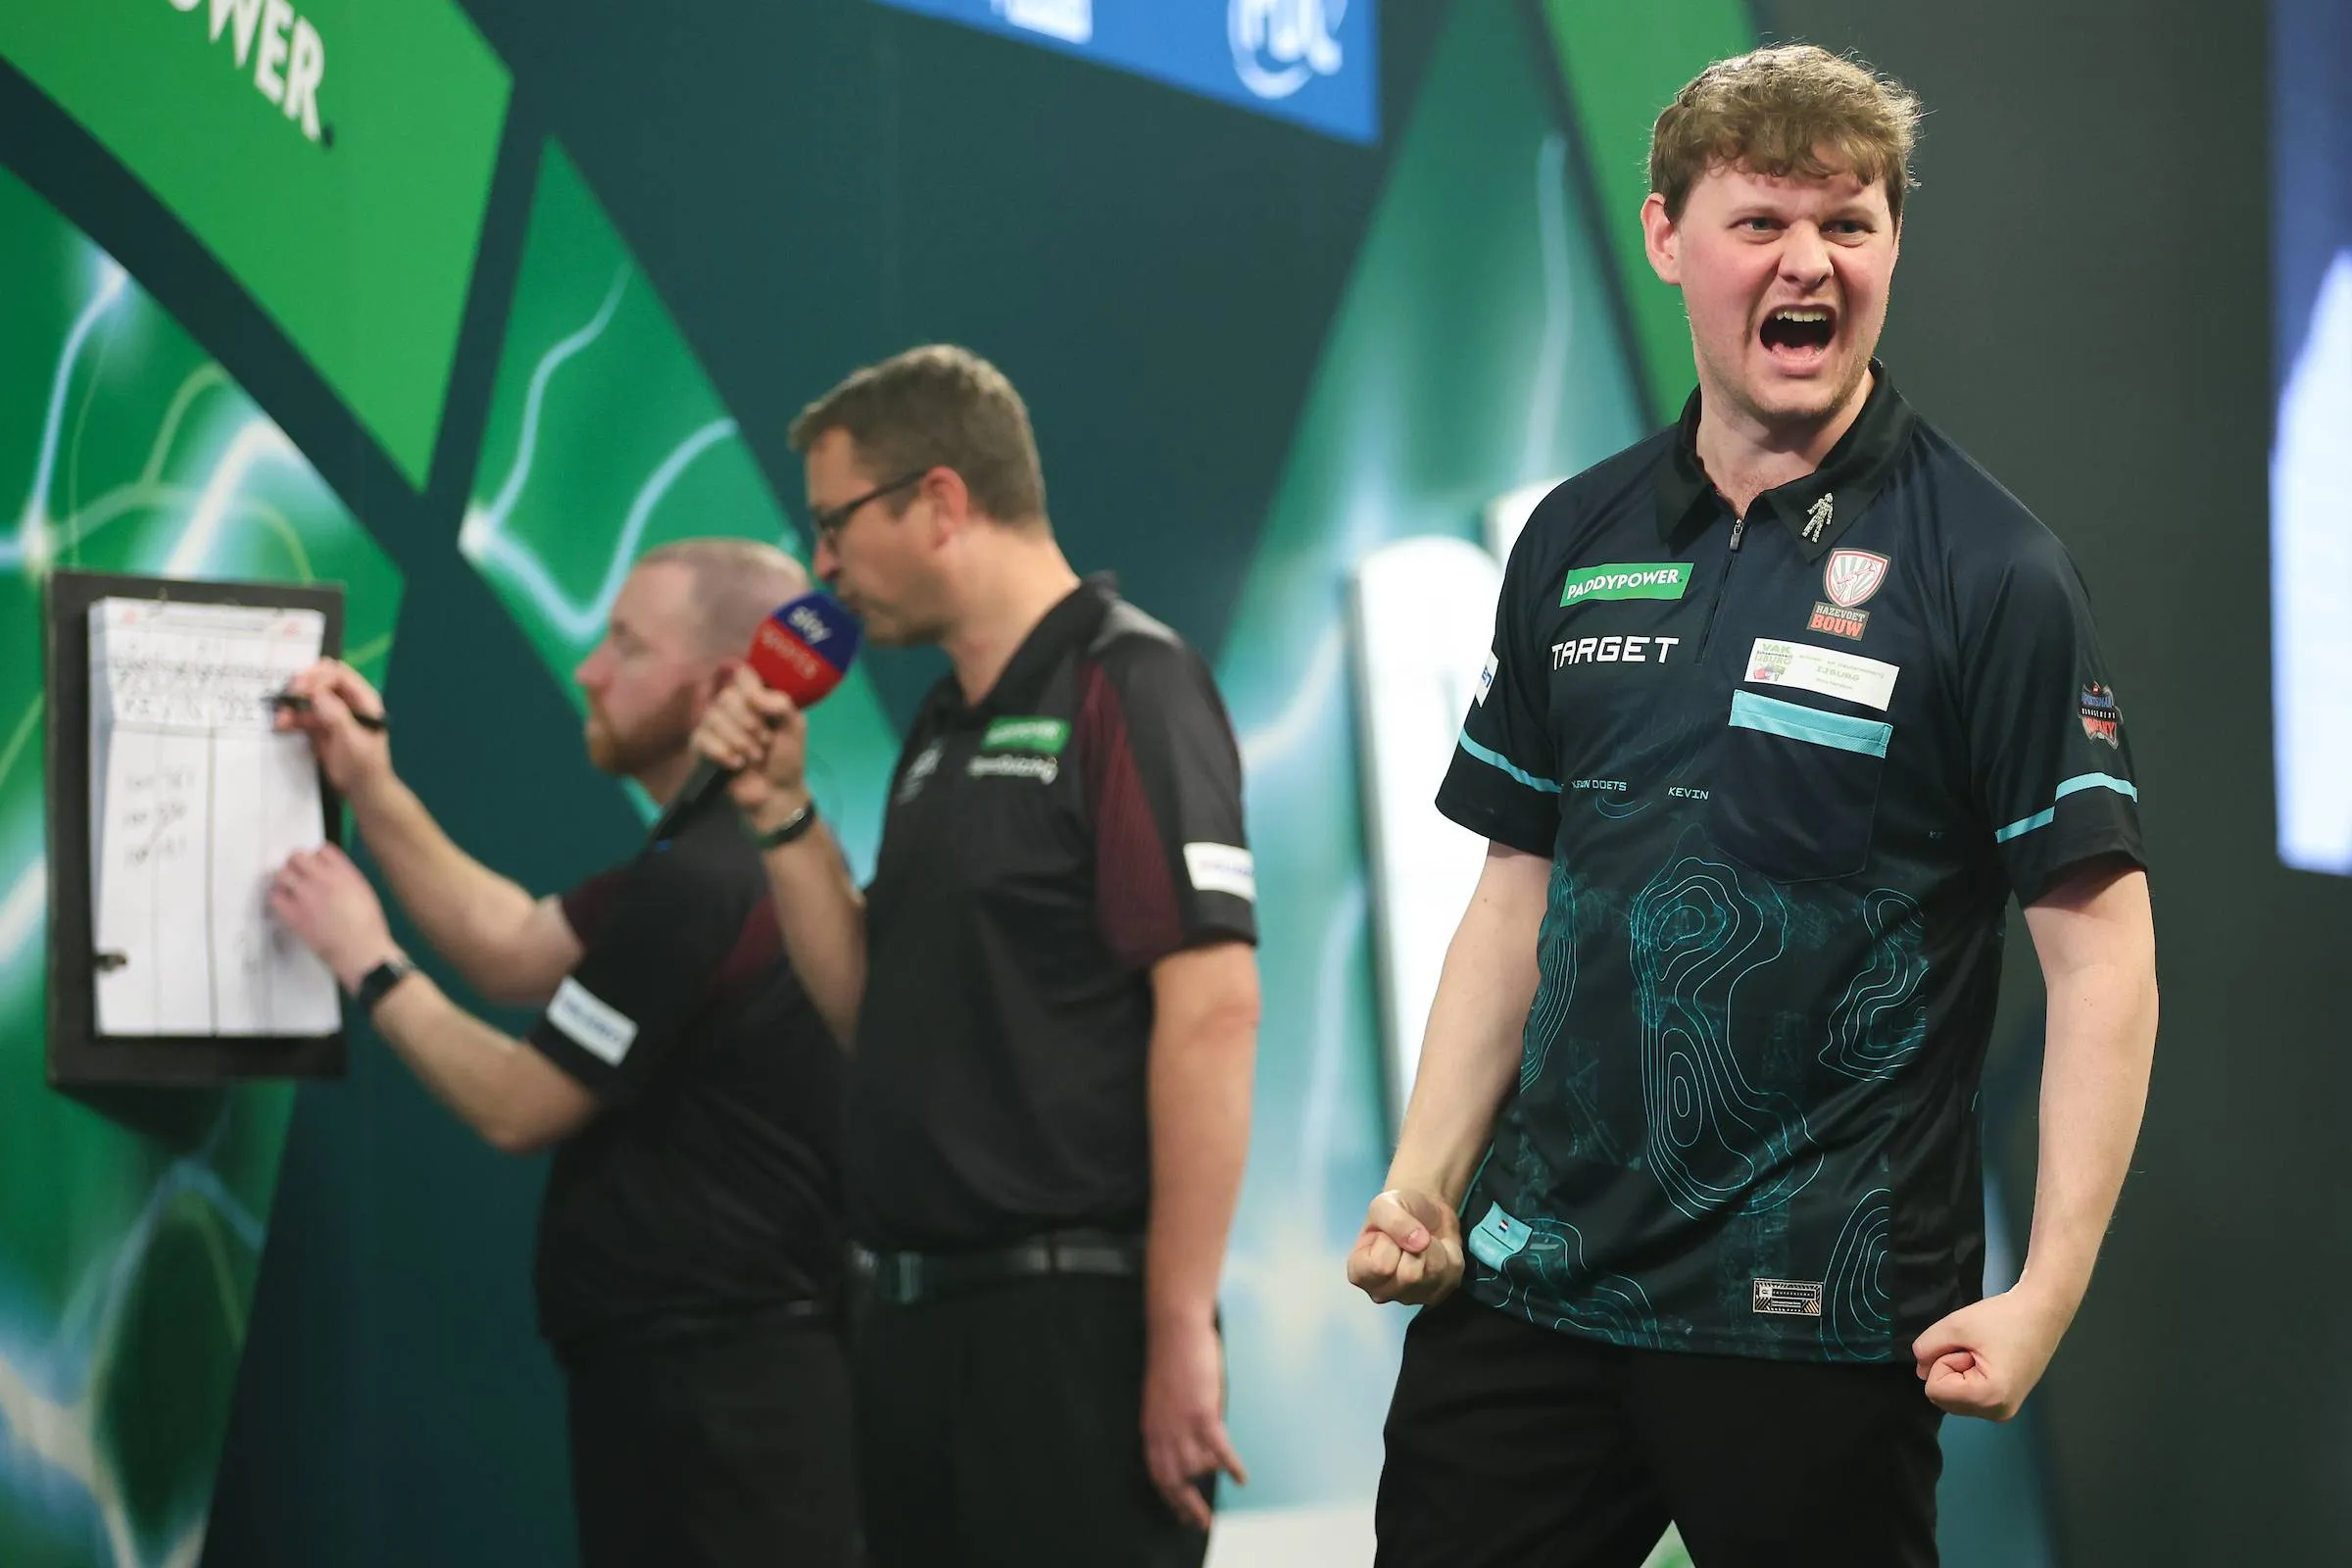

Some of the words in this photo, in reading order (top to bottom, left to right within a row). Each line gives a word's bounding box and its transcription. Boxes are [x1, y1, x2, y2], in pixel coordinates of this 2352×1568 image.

[1815, 605, 1866, 622] HAZEVOET
[1810, 613, 1863, 636] BOUW
[1551, 636, 1680, 670] TARGET
[1762, 643, 1791, 654] VAK
[1592, 779, 1627, 791] DOETS
[1668, 786, 1709, 800] KEVIN
